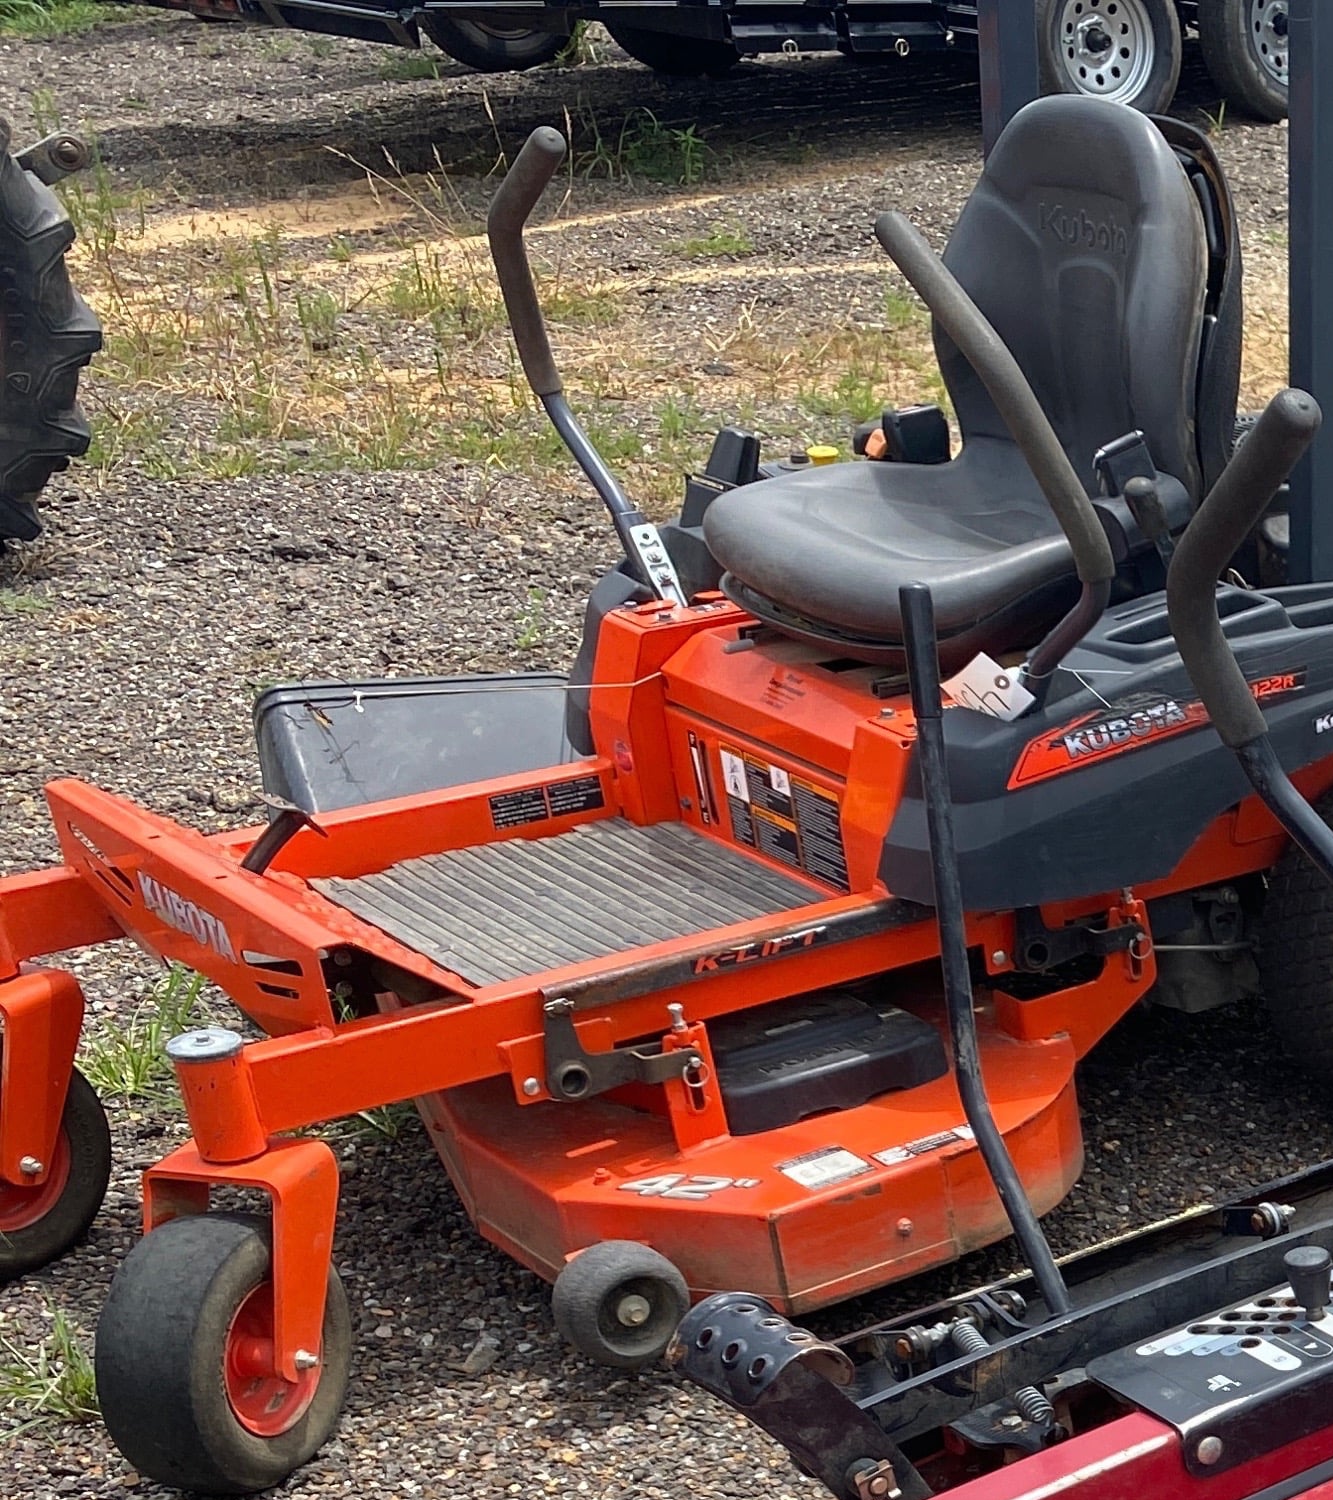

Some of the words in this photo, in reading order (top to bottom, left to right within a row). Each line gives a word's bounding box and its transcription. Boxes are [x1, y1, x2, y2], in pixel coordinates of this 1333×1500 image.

[1039, 201, 1128, 256] Kubota
[1250, 673, 1295, 699] 122R
[1063, 701, 1187, 758] KUBOTA
[136, 868, 239, 965] KUBOTA
